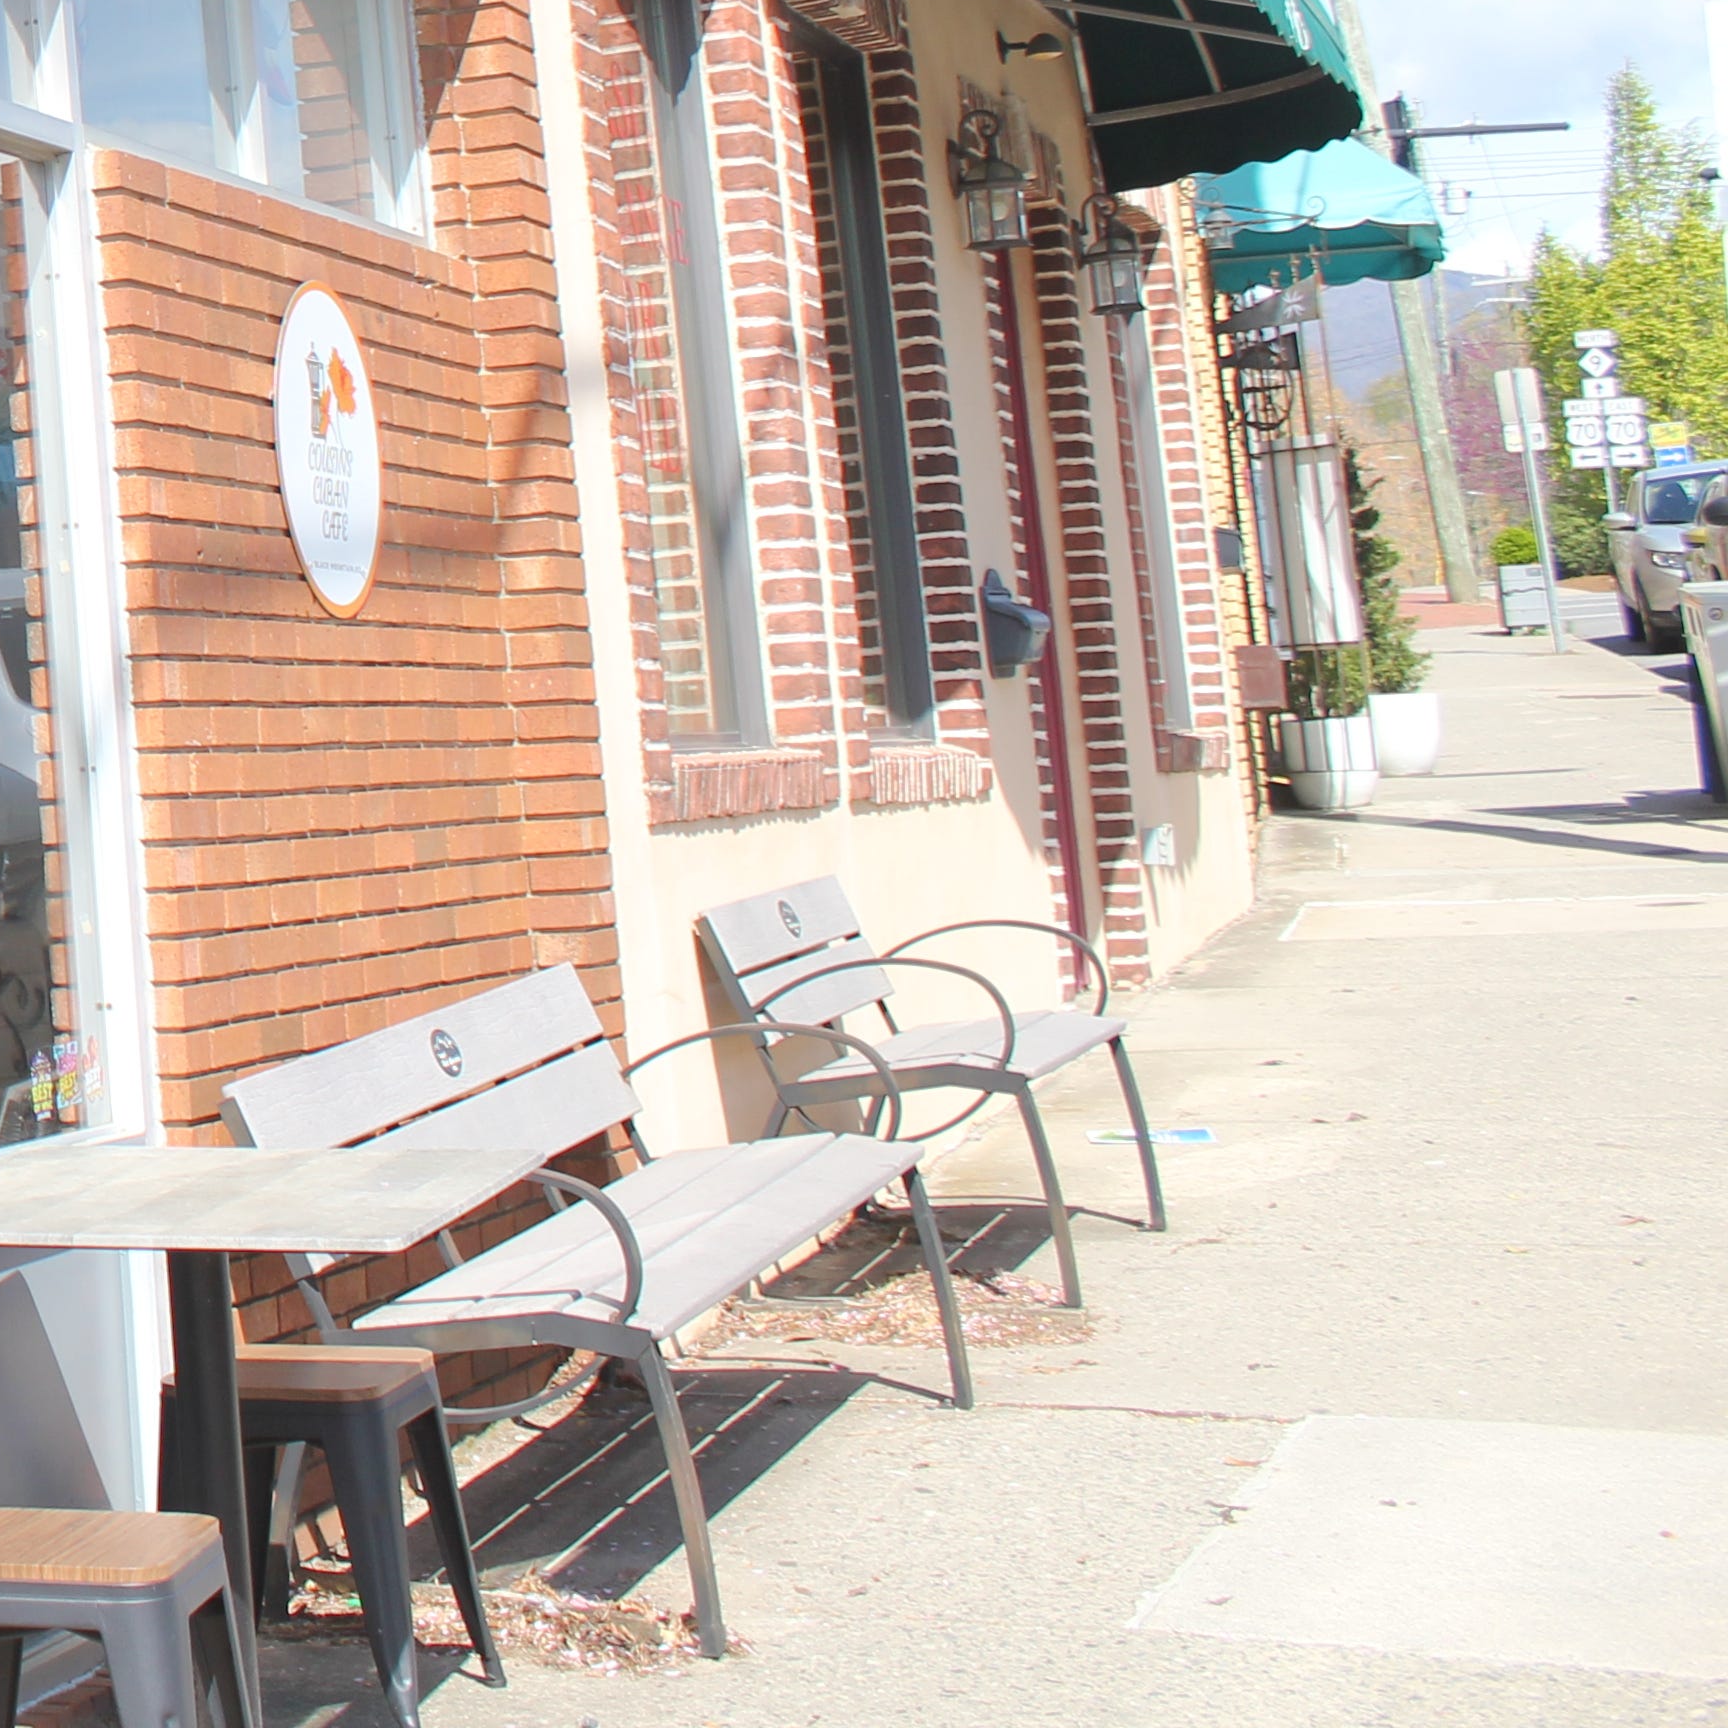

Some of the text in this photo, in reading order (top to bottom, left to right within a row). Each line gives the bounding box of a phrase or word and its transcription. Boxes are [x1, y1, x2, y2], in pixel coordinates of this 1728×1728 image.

[1589, 355, 1601, 371] 9
[1571, 421, 1636, 440] 70 70
[308, 441, 353, 478] COUSINS
[312, 475, 350, 510] CUBAN
